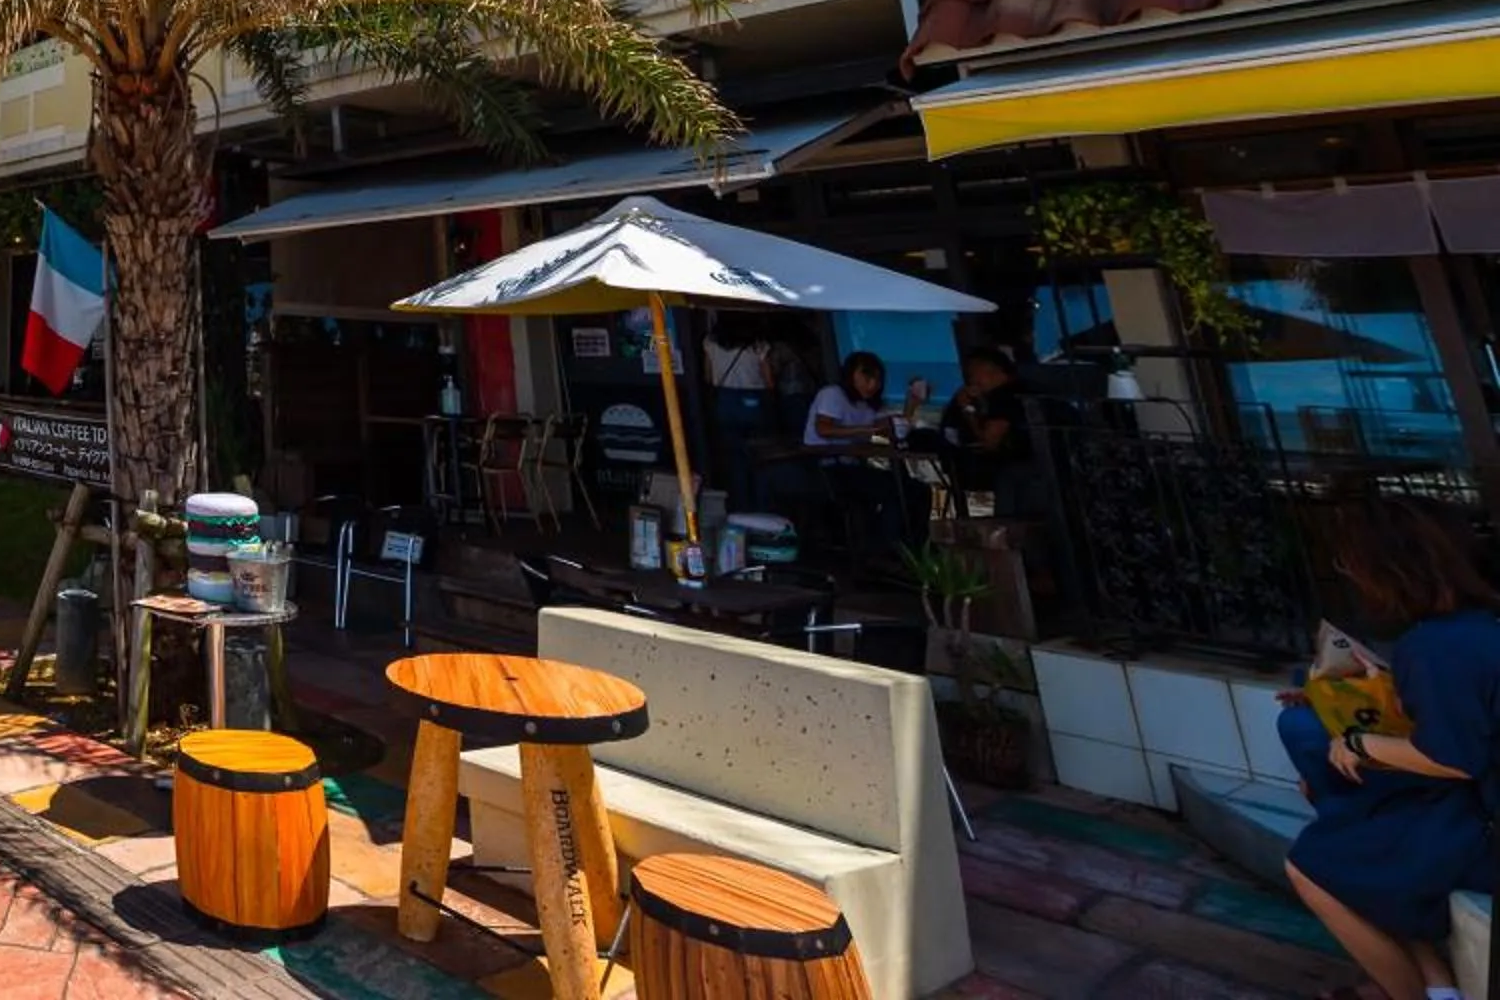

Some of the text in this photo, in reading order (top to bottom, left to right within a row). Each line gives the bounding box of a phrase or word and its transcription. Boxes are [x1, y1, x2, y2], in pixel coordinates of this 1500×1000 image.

[13, 415, 107, 444] ITALIAN COFFEE TO
[550, 788, 588, 928] BOARDWALK
